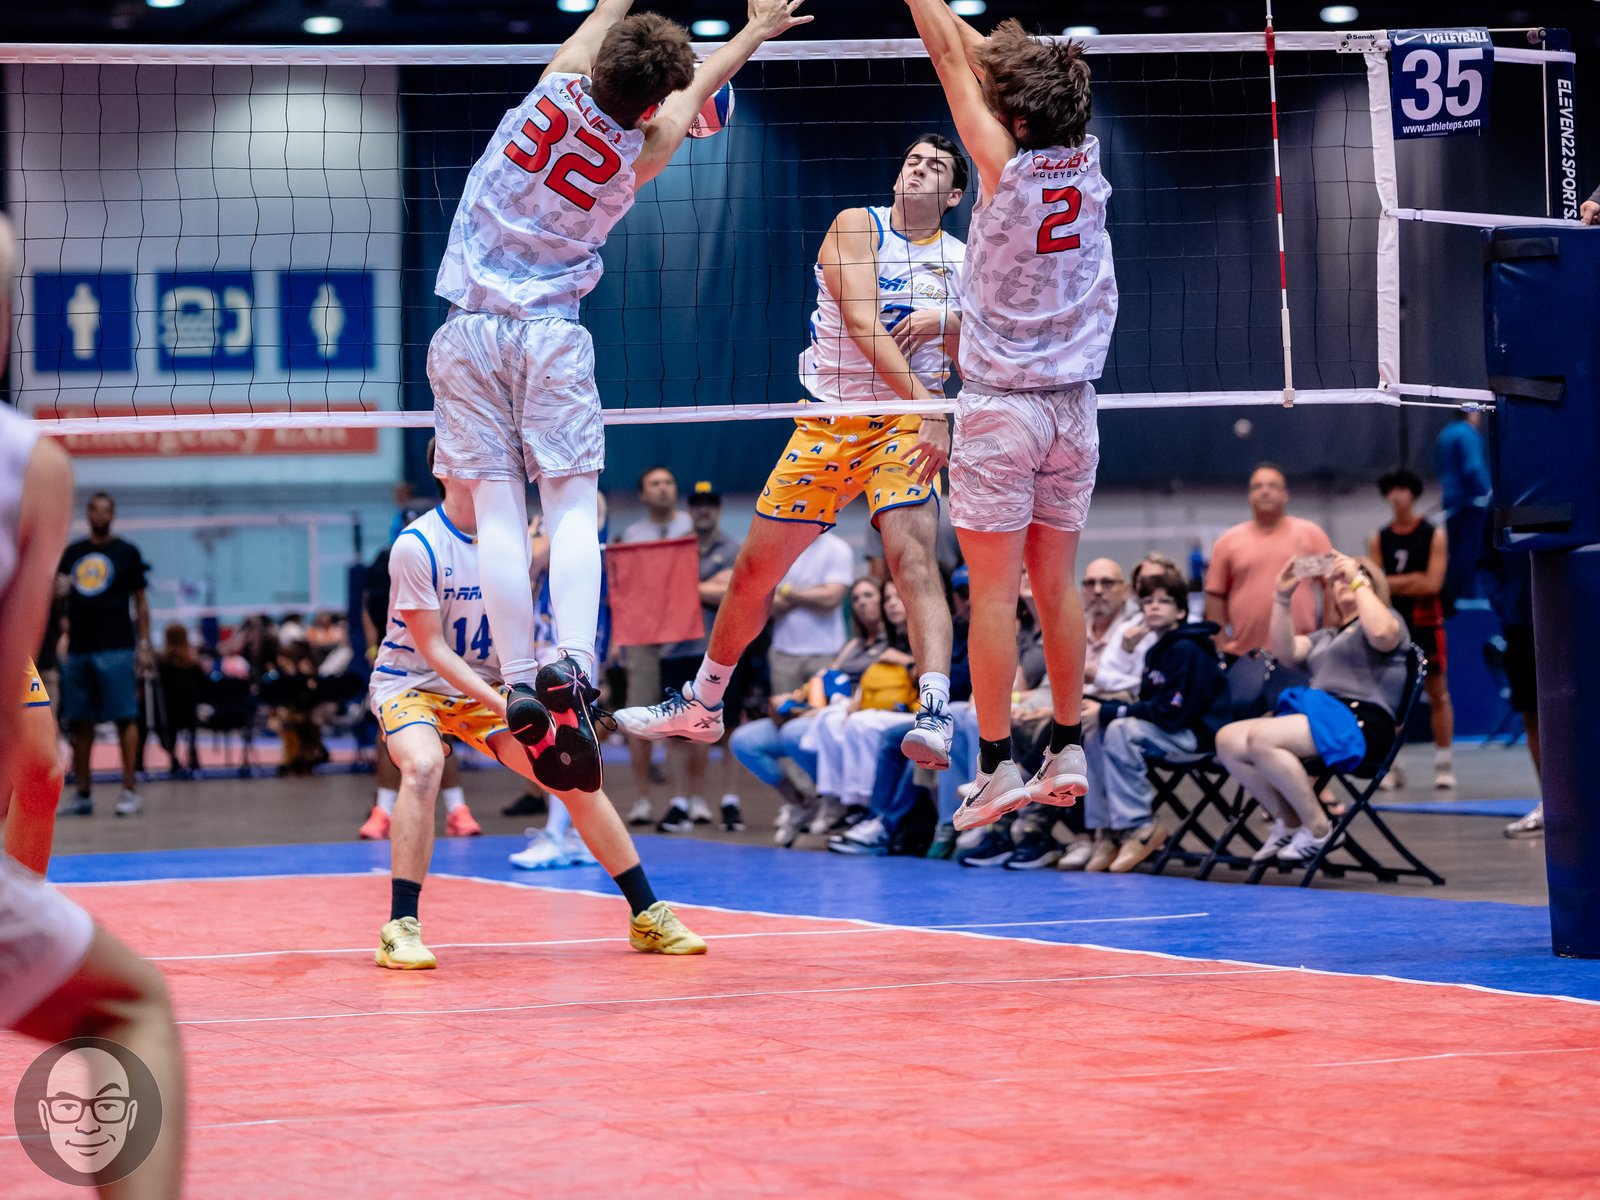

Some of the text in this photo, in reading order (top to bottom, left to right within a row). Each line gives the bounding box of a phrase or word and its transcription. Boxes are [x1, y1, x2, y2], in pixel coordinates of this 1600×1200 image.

[1423, 31, 1489, 44] VOLLEYBALL
[1400, 47, 1483, 121] 35
[503, 94, 622, 212] 32
[1402, 118, 1481, 134] www.athleteps.com
[1036, 185, 1083, 255] 2
[453, 613, 493, 660] 14
